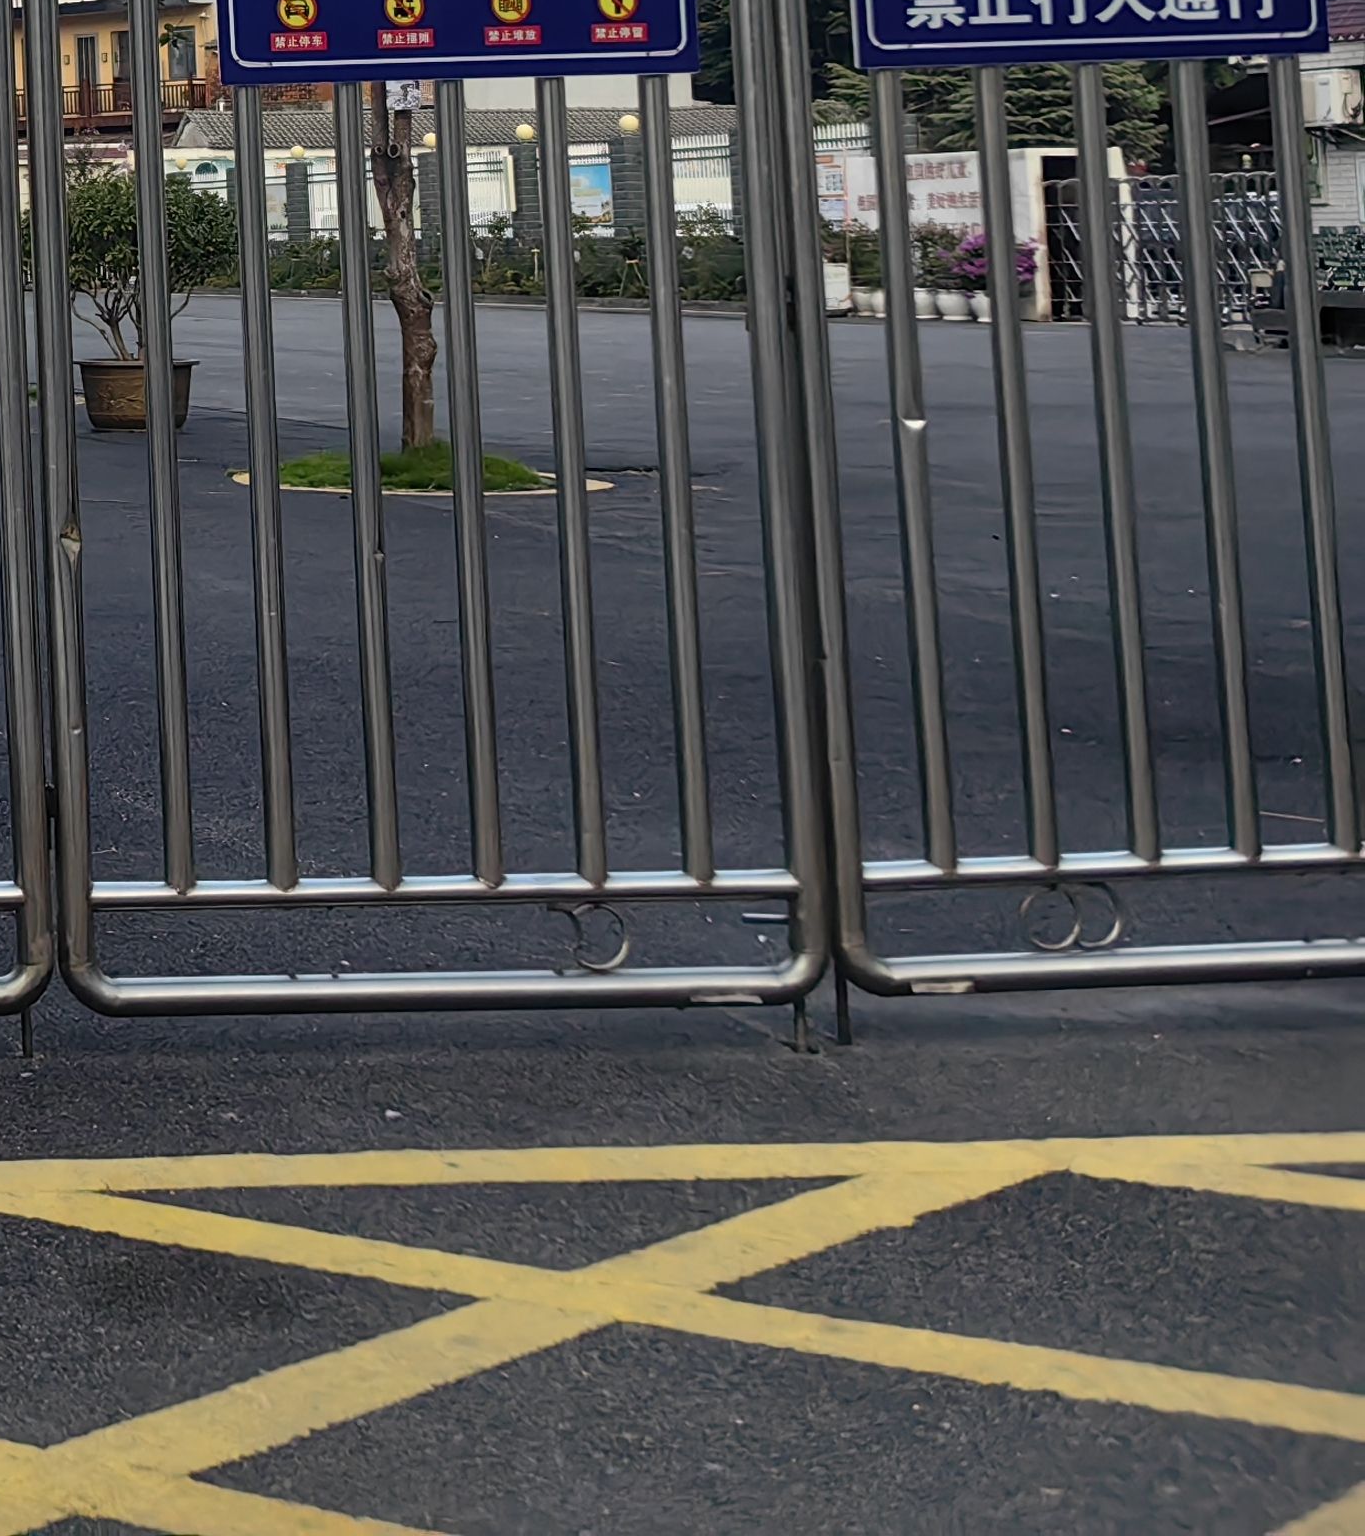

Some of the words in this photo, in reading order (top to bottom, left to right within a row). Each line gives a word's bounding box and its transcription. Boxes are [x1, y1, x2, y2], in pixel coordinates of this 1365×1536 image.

[595, 26, 644, 39] 禁止停留
[275, 35, 324, 48] 禁止停车
